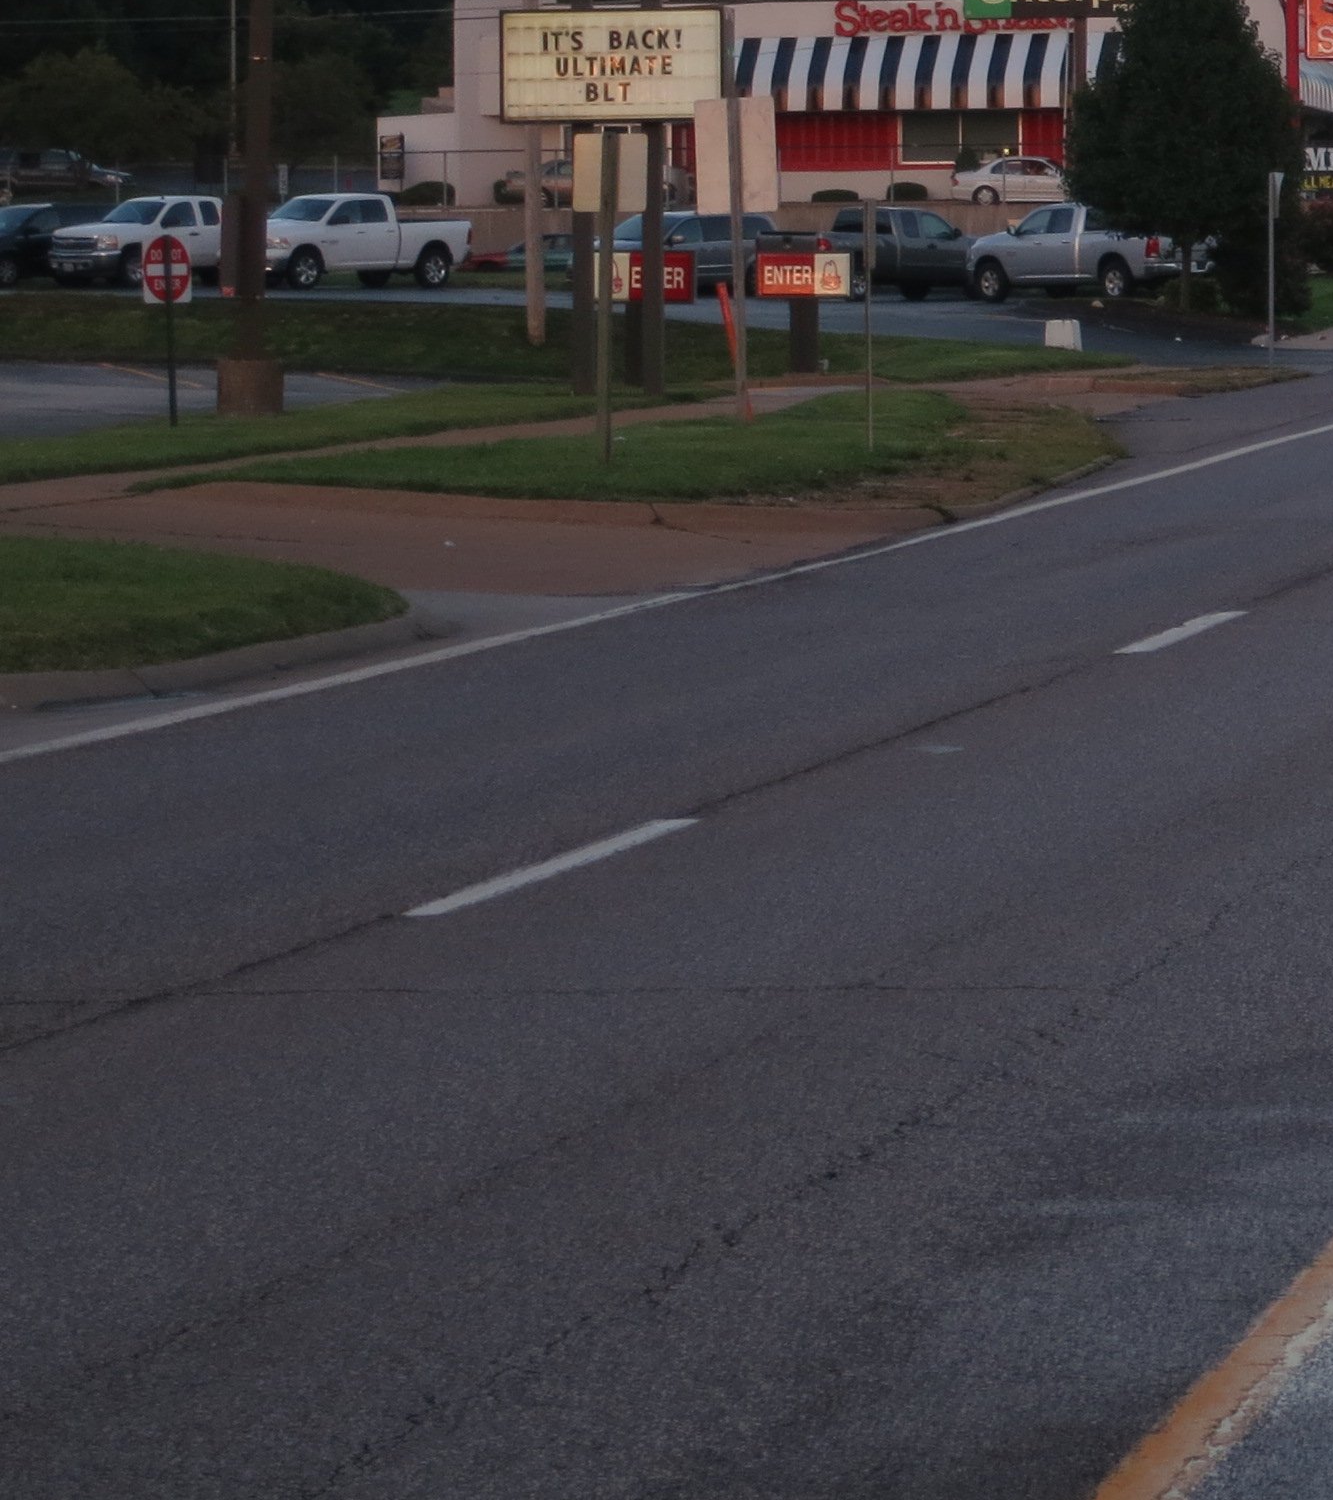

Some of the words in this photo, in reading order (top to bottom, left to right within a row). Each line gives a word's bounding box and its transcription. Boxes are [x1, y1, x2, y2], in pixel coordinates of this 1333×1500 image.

[835, 0, 933, 37] Steak
[542, 31, 584, 51] IT'S
[609, 29, 683, 50] BACK!
[555, 56, 673, 77] ULTIMATE
[585, 82, 632, 102] BLT
[1303, 175, 1317, 189] LL
[154, 279, 181, 291] ENER
[631, 266, 685, 290] EER
[763, 266, 811, 287] ENTER
